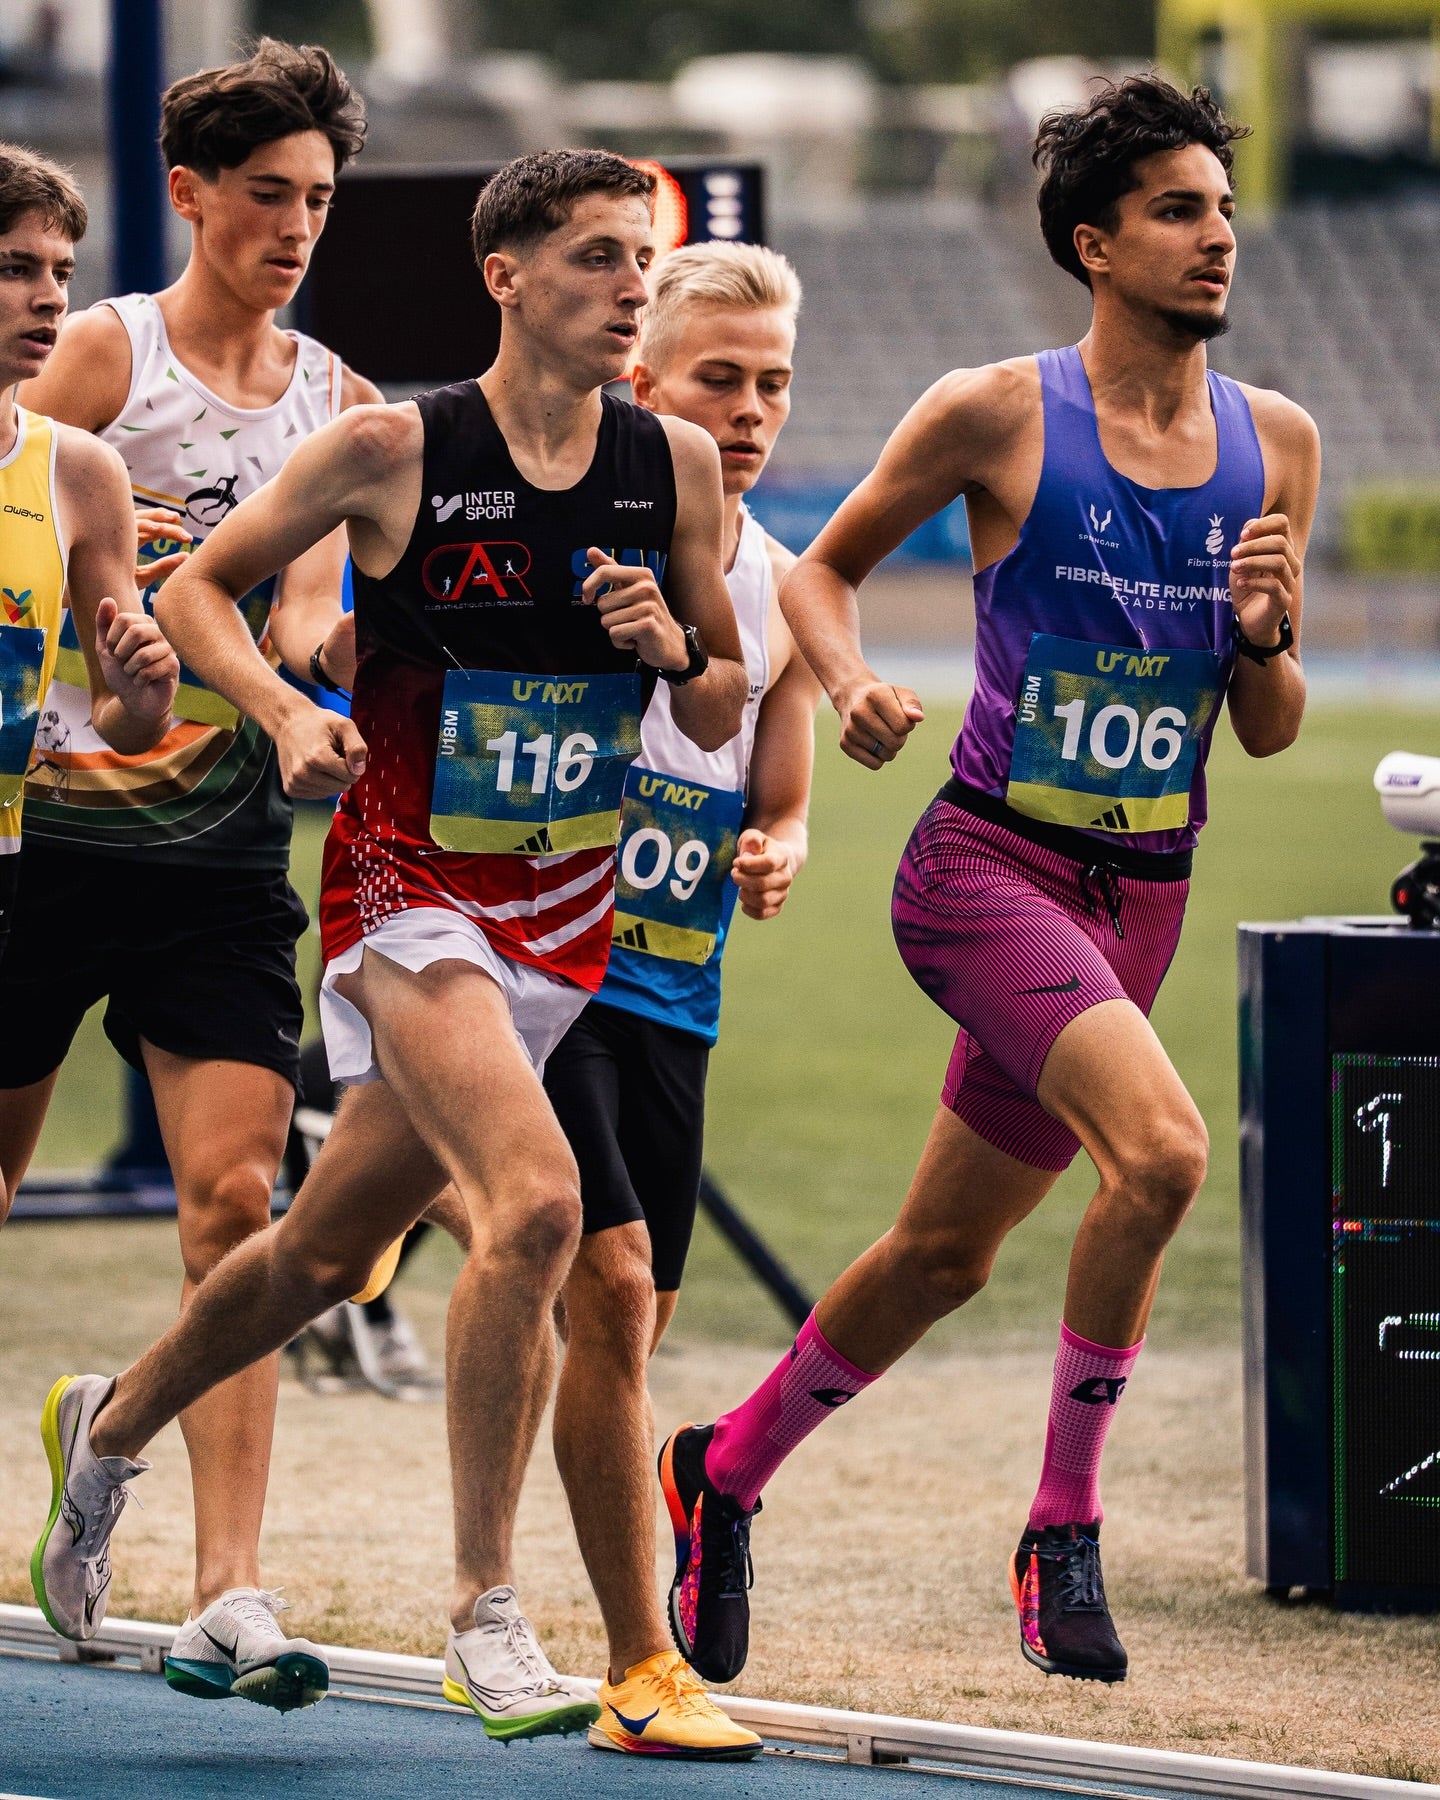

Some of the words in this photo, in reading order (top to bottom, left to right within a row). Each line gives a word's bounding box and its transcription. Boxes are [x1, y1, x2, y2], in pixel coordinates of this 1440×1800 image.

[466, 491, 515, 506] INTER
[613, 500, 654, 510] START
[465, 505, 516, 520] SPORT
[1187, 558, 1211, 567] Fibre
[1111, 592, 1197, 612] ACADEMY
[1163, 584, 1233, 603] RUNNING
[1020, 675, 1042, 723] U18M
[441, 710, 459, 756] U18M
[1053, 698, 1187, 771] 106
[486, 730, 598, 794] 116
[621, 827, 710, 901] 09
